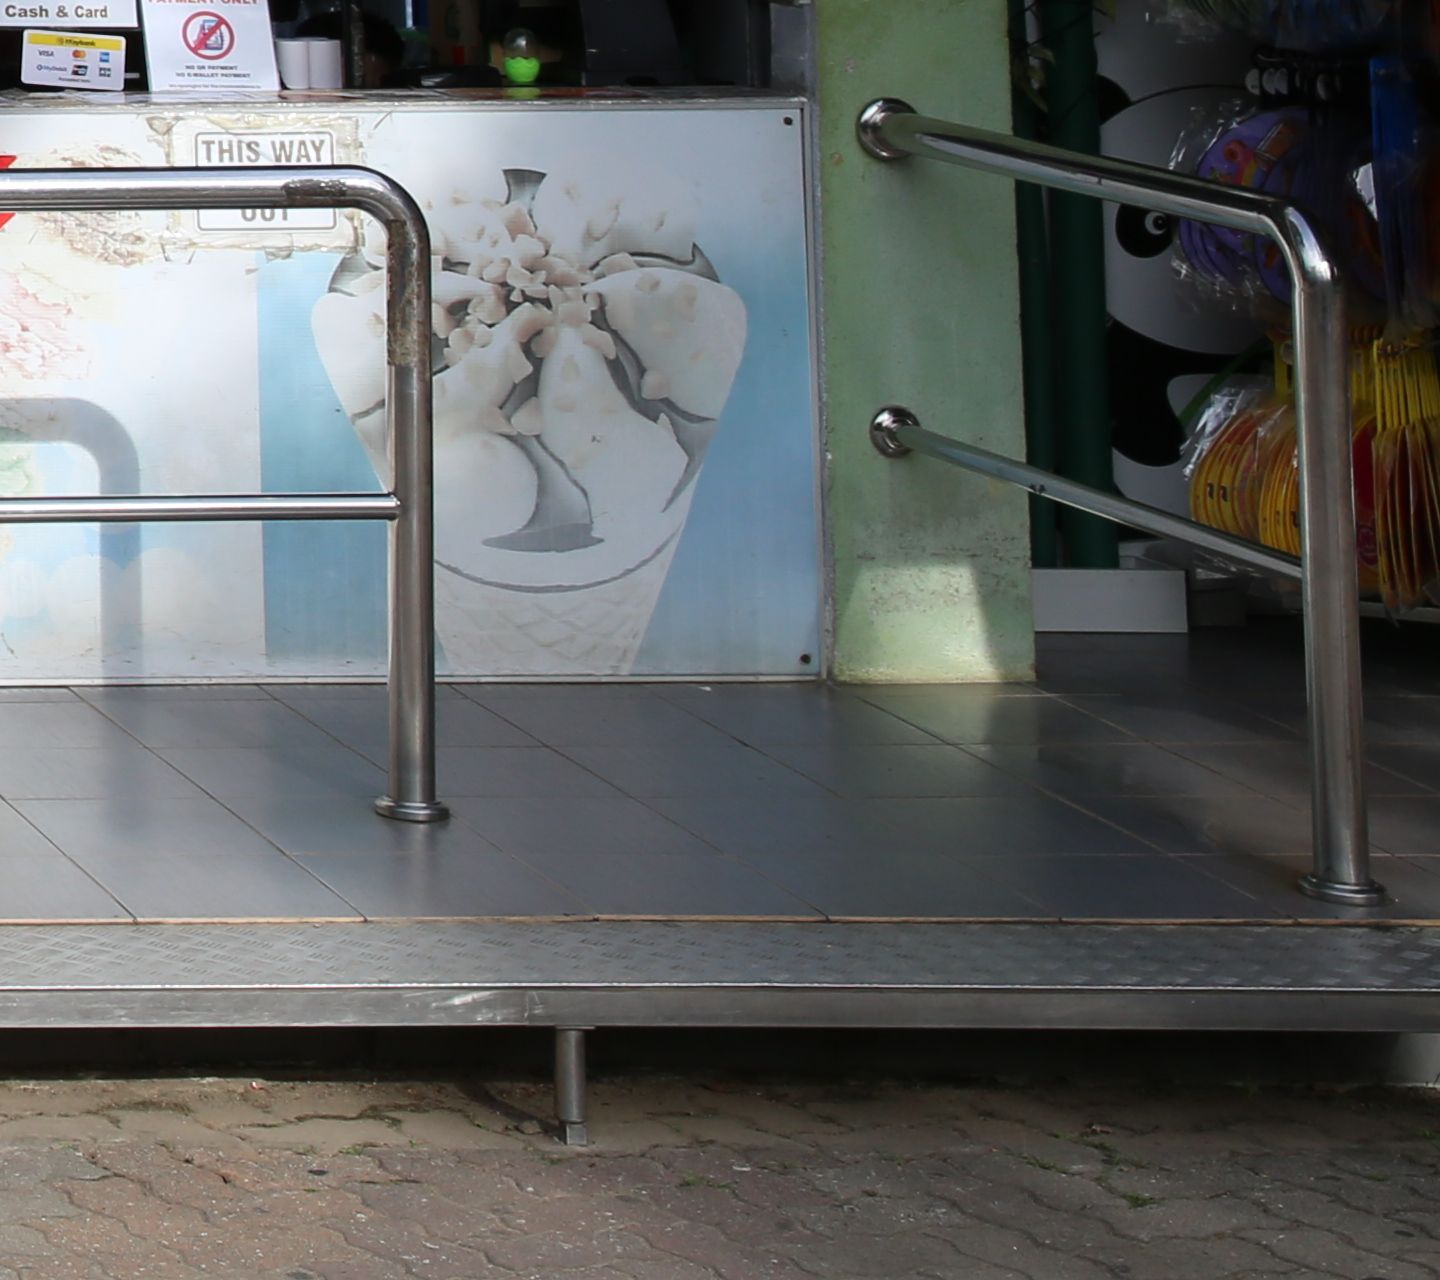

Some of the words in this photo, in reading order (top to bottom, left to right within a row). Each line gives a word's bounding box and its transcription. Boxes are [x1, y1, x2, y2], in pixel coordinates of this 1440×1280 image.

[5, 4, 50, 19] Cash
[56, 5, 69, 18] &
[75, 4, 108, 19] Card
[37, 49, 55, 57] VISA
[200, 139, 261, 163] THIS
[271, 139, 326, 163] WAY
